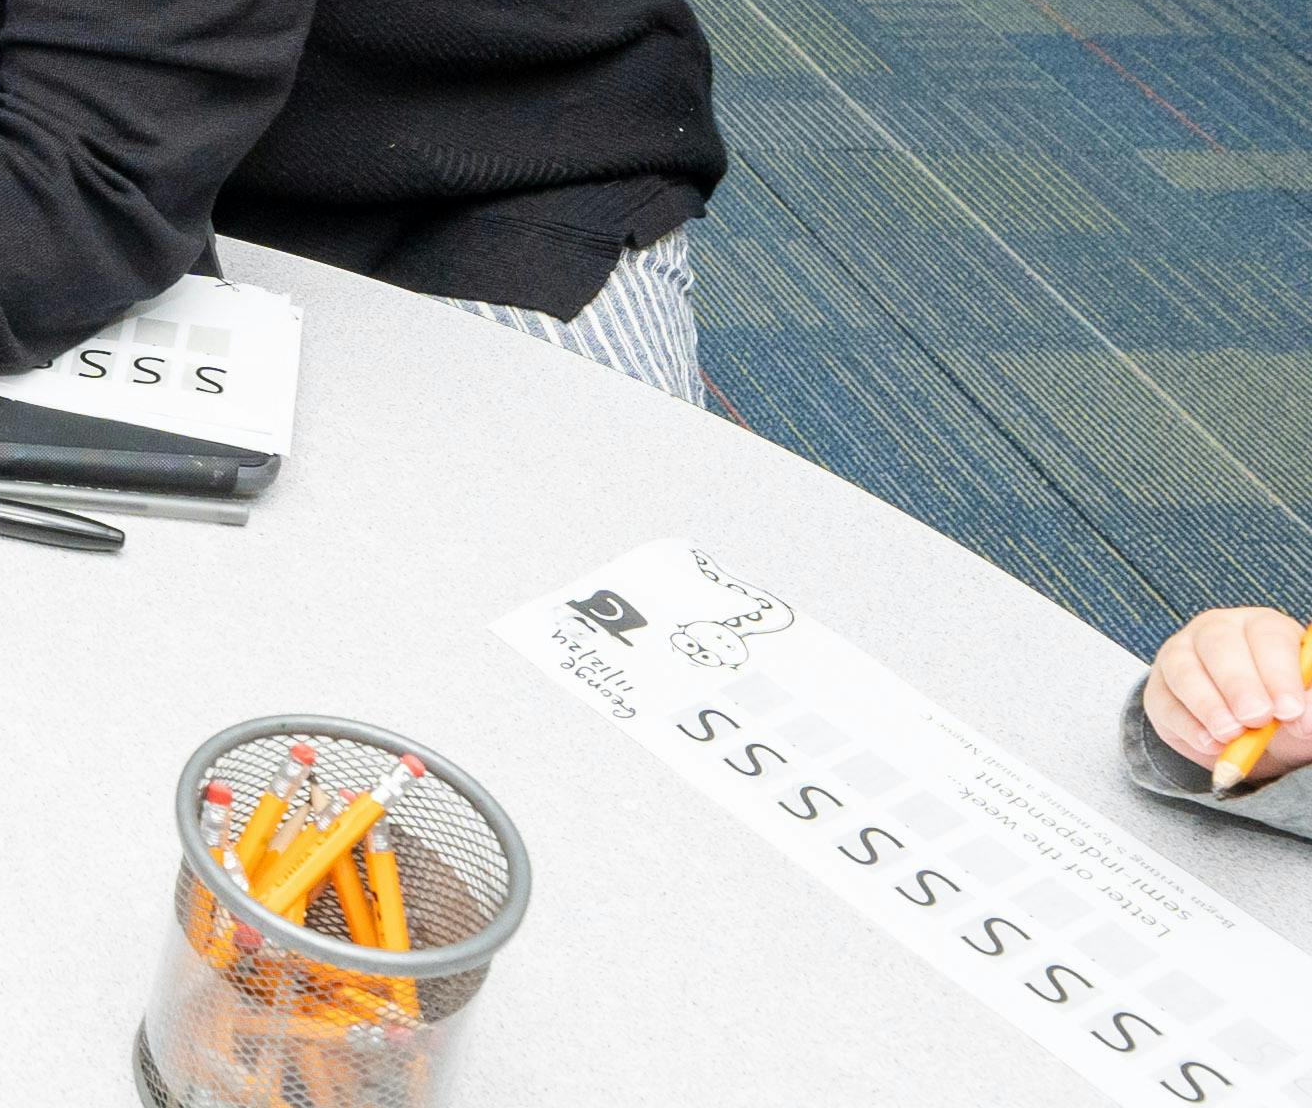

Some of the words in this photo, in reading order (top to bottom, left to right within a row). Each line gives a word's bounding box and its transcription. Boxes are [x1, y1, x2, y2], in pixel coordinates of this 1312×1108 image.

[78, 349, 112, 379] S
[133, 356, 166, 385] S
[195, 366, 228, 394] S
[551, 629, 635, 693] 11/12/24
[560, 656, 637, 719] George
[676, 709, 742, 743] S
[722, 743, 789, 777] S
[777, 785, 845, 821] S
[836, 826, 906, 866] S
[975, 770, 1193, 922] semi-independent
[1021, 828, 1065, 863] the
[894, 869, 963, 908] S
[1061, 859, 1094, 882] of
[1099, 884, 1172, 940] Letter
[960, 917, 1033, 957] S
[1023, 964, 1095, 1005] S
[1090, 1011, 1165, 1054] S
[1159, 1061, 1235, 1104] S
